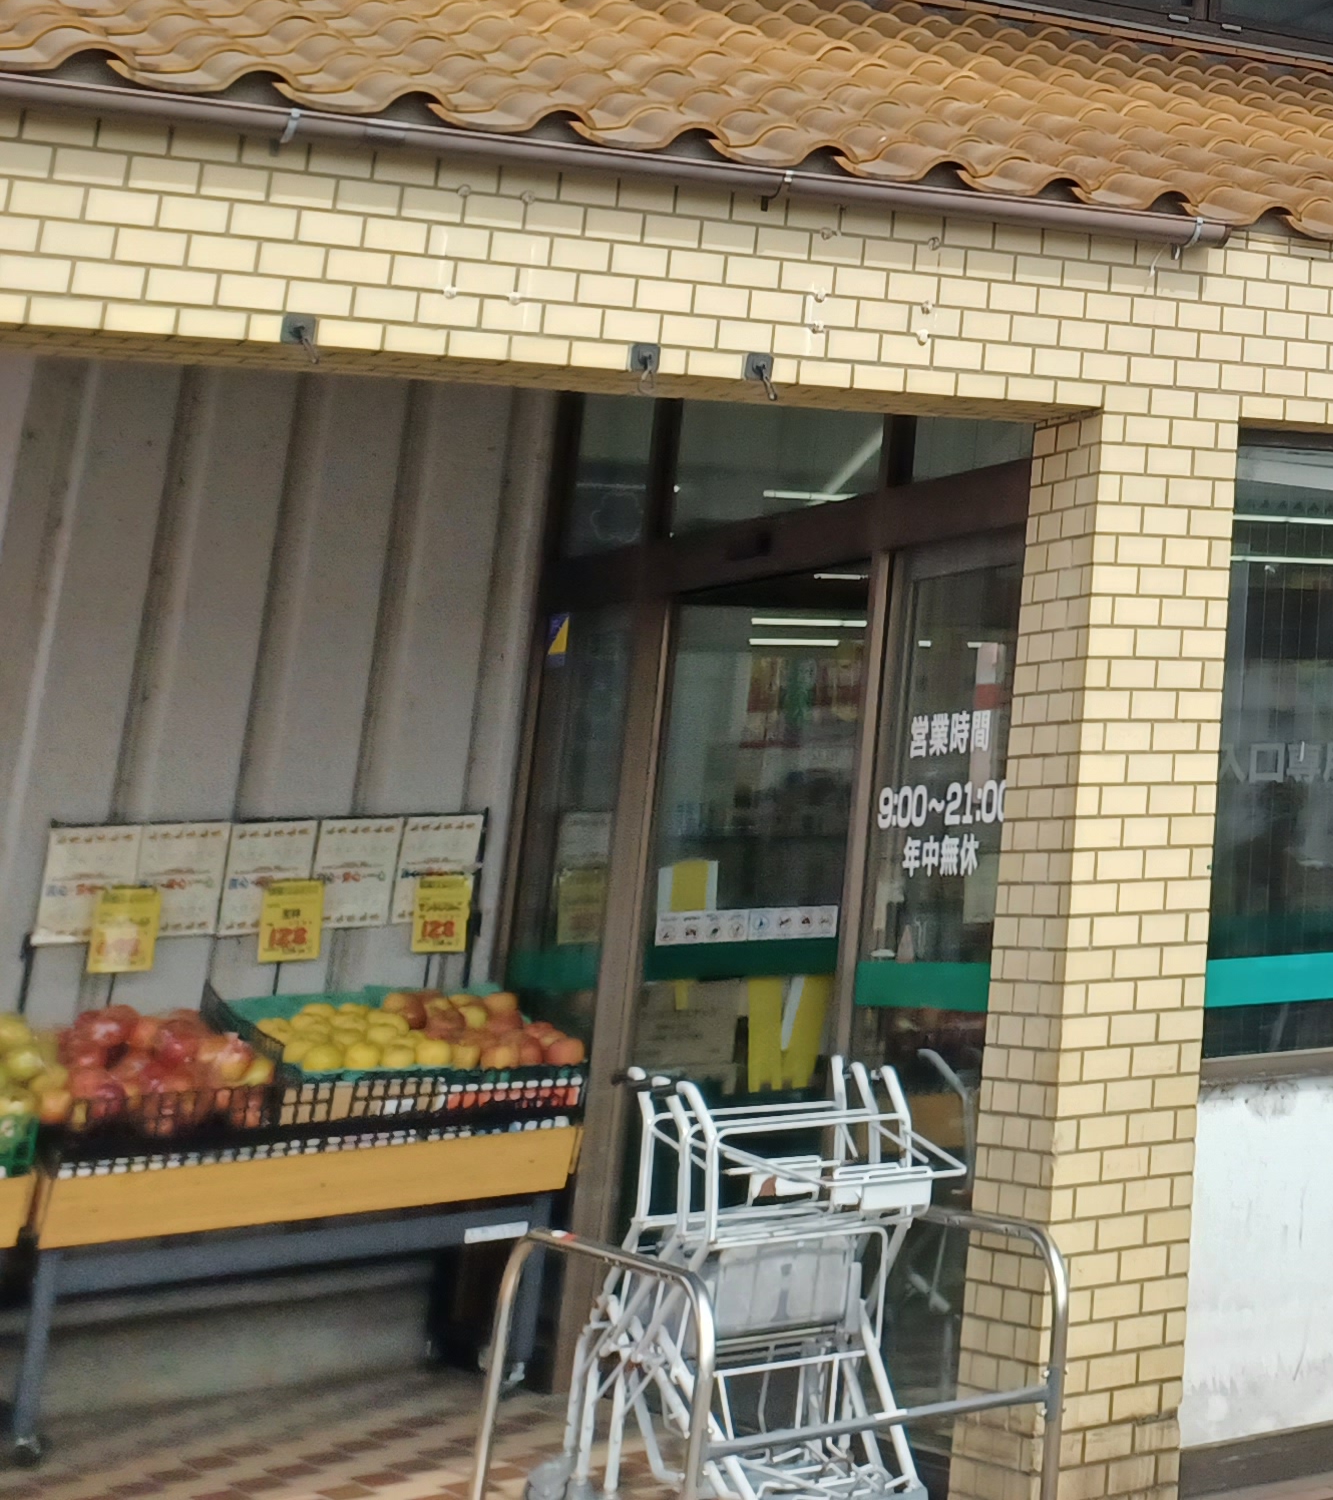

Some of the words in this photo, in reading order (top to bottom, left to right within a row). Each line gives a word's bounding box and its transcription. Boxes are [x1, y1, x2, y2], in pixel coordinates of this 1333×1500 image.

[909, 709, 992, 759] 営業時間
[902, 833, 980, 878] 年中無休
